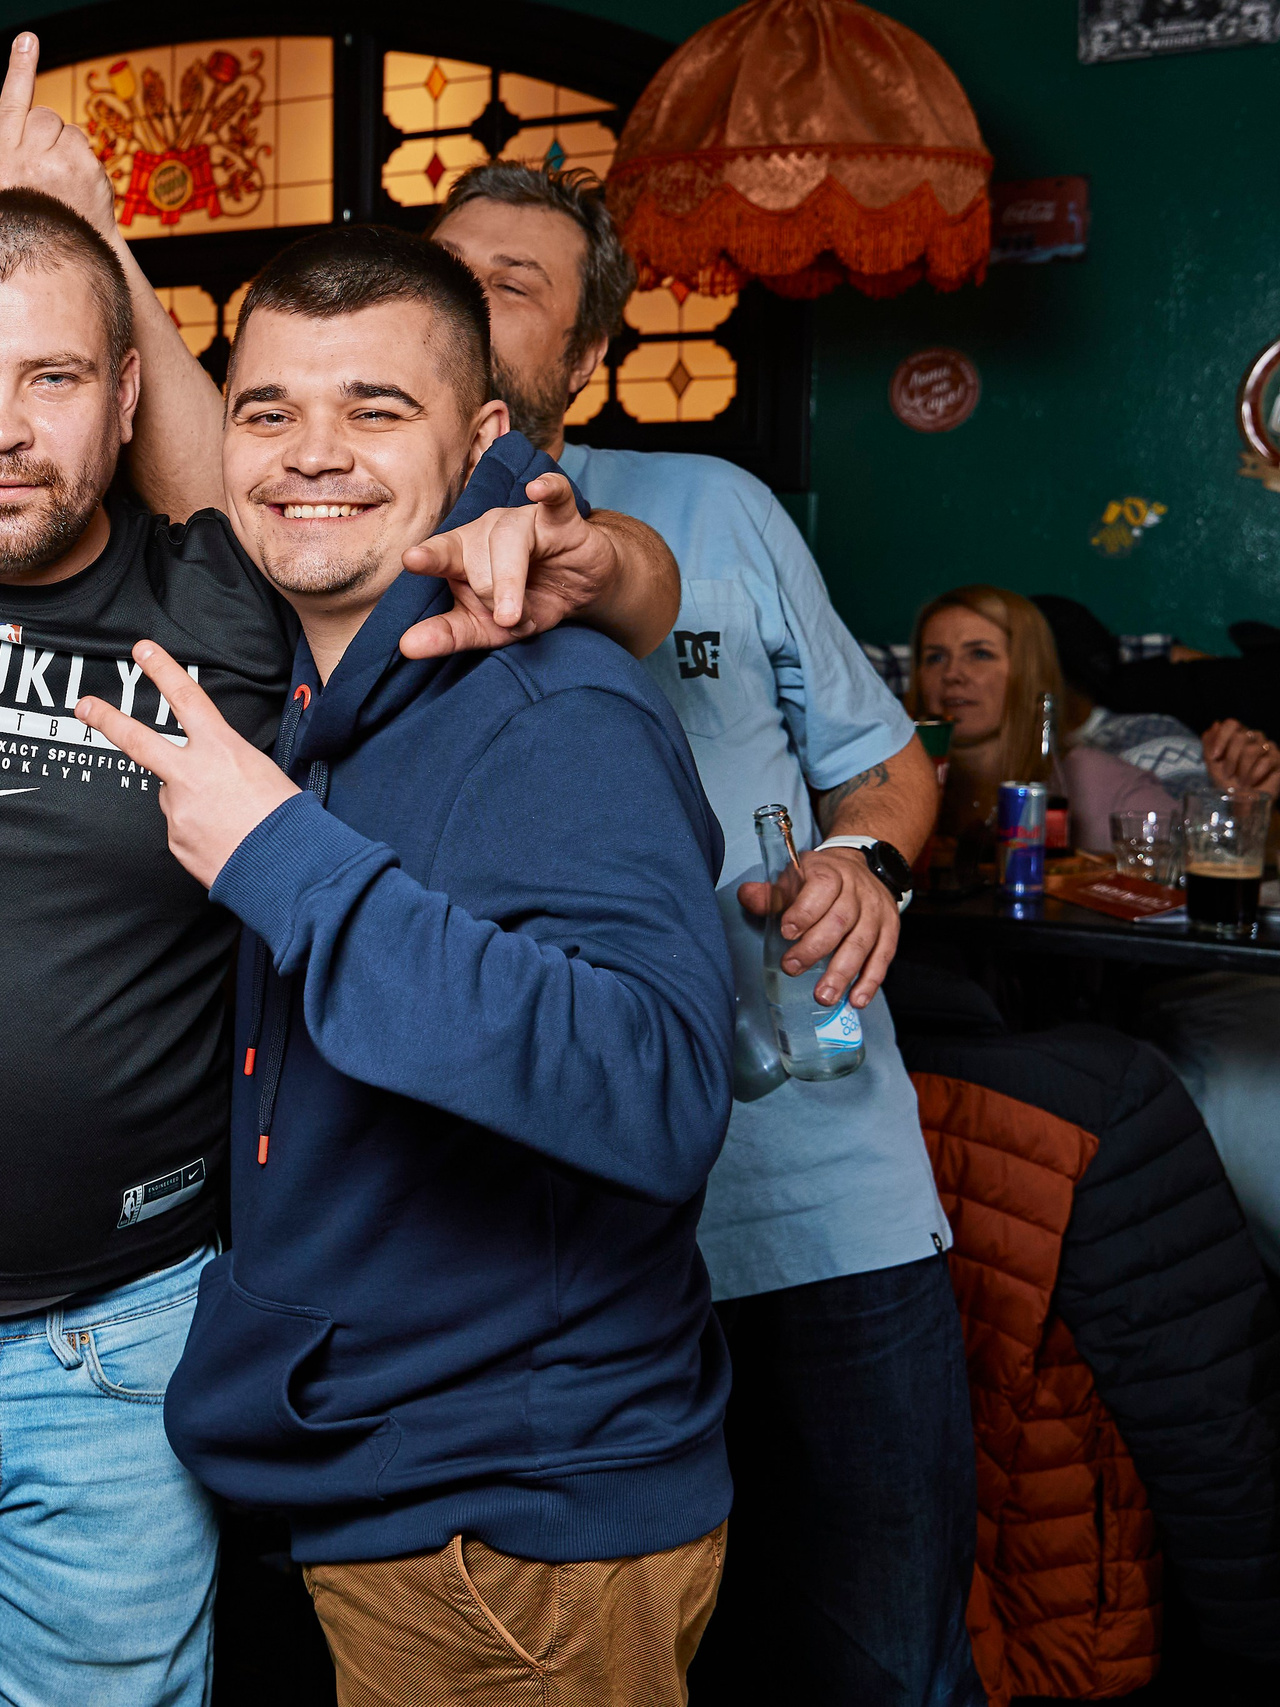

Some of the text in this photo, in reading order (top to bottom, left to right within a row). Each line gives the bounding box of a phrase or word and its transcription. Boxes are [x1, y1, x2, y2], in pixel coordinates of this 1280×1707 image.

[48, 748, 151, 775] SPECIFICA
[121, 776, 164, 791] NE
[148, 1176, 179, 1193] ENGINEERED
